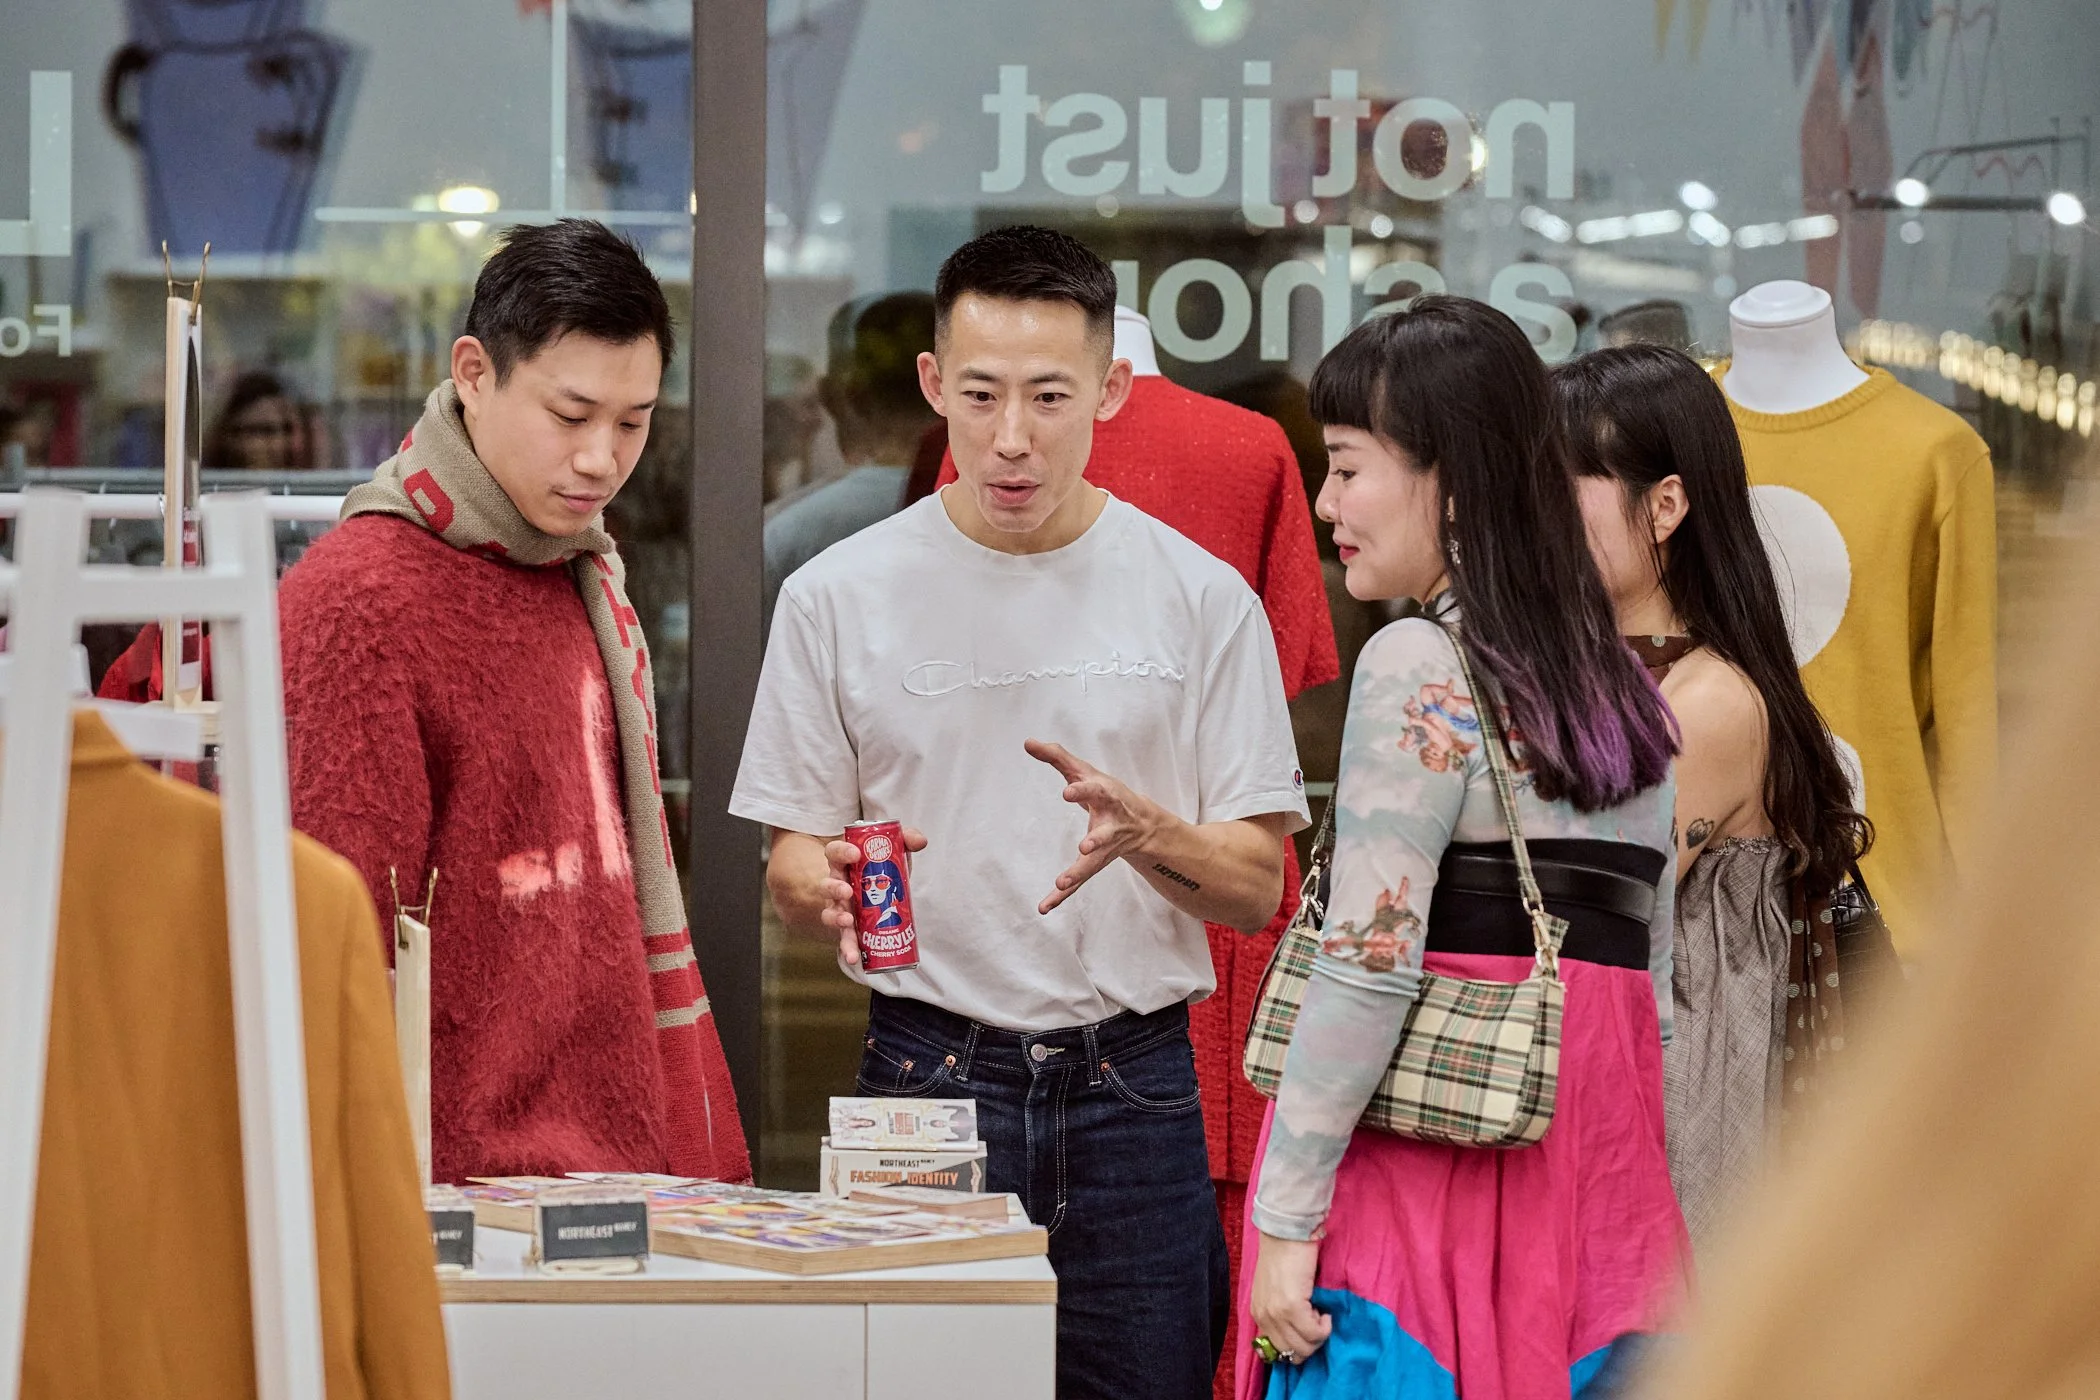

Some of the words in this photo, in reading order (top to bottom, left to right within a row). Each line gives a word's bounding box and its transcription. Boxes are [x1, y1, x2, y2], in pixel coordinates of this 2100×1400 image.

[901, 649, 1185, 697] Champion
[862, 931, 903, 950] CHERRY
[870, 950, 896, 958] CHERRY
[896, 945, 912, 956] SODA
[879, 1159, 920, 1168] NORTHEAST
[850, 1170, 903, 1184] FASHION
[907, 1170, 959, 1186] IDENTITY
[557, 1224, 614, 1241] NORTHEAST
